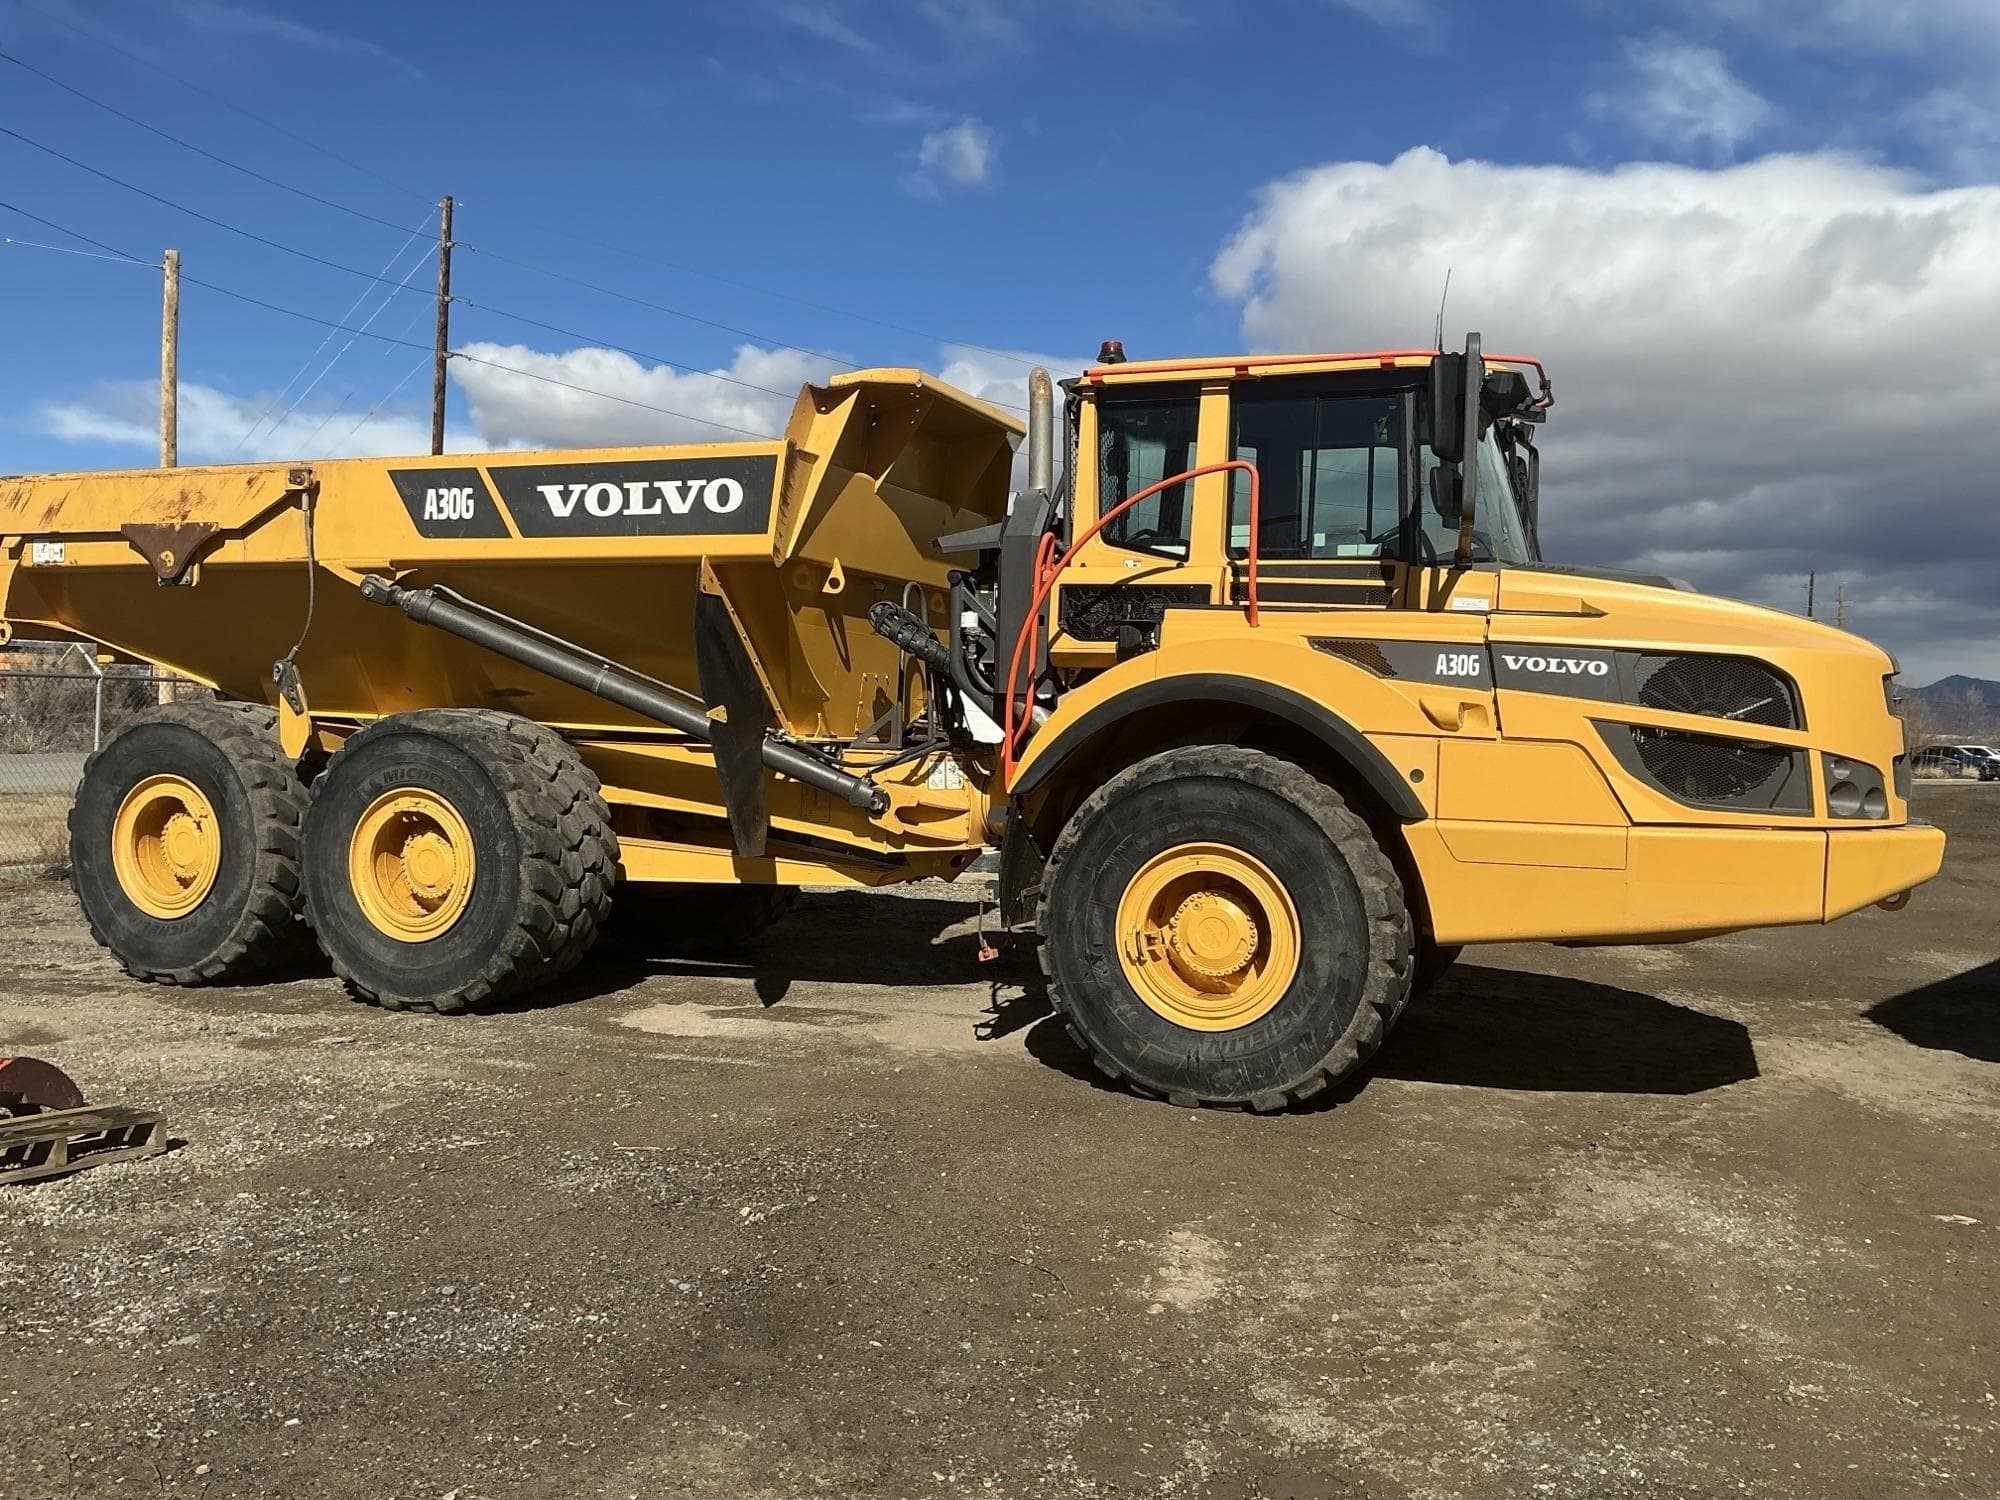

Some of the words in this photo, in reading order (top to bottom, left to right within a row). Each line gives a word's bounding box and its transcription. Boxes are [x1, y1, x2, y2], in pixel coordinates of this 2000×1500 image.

[424, 487, 474, 520] A30G
[536, 478, 743, 517] VOLVO
[1435, 654, 1480, 676] A30G
[1502, 654, 1608, 676] VOLVO
